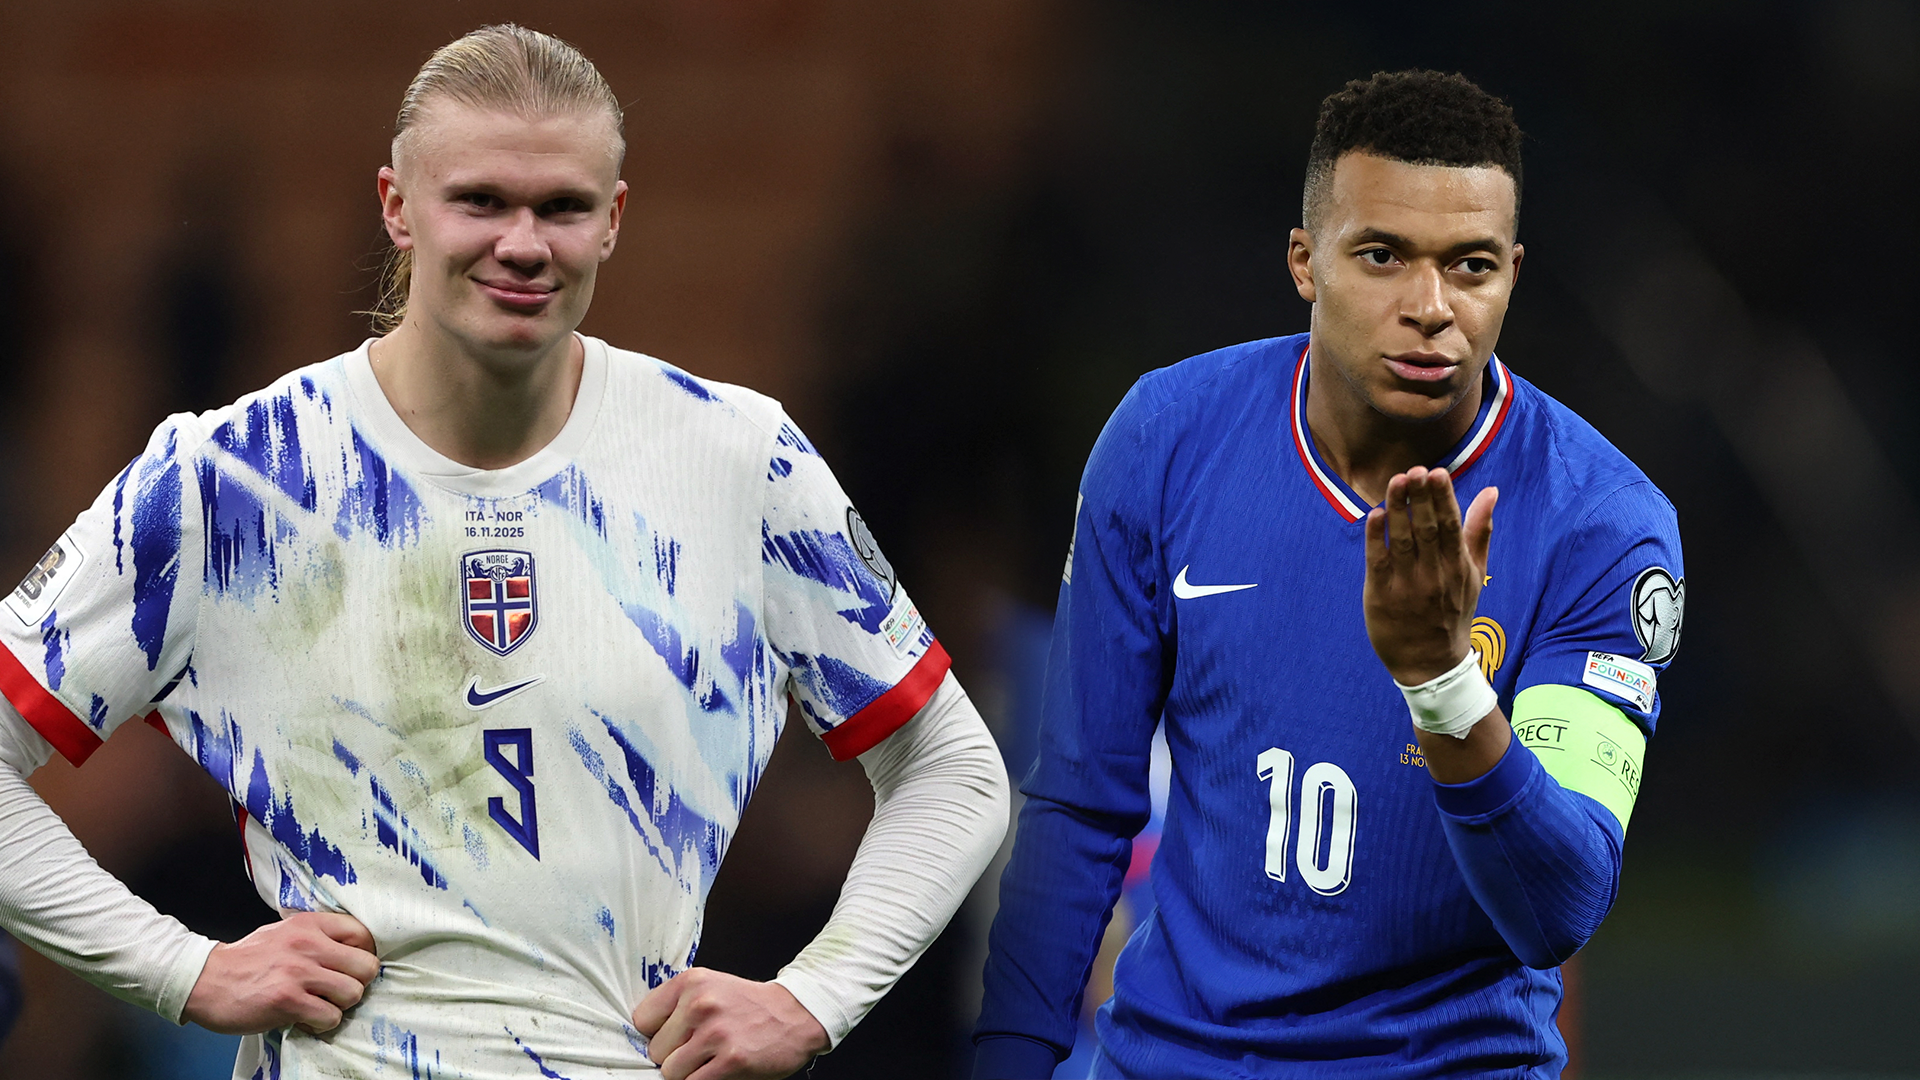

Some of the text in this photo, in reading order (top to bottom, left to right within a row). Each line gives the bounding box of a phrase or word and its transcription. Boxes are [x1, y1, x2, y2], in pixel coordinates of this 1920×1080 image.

[465, 511, 485, 522] ITA
[496, 511, 523, 522] NOR
[464, 527, 525, 538] 16.11.2025
[486, 554, 509, 564] NORGE
[1591, 651, 1614, 662] UEFA
[1406, 743, 1424, 757] FRA
[1400, 753, 1428, 768] 13 NO
[483, 727, 541, 862] 9
[1256, 746, 1359, 897] 10
